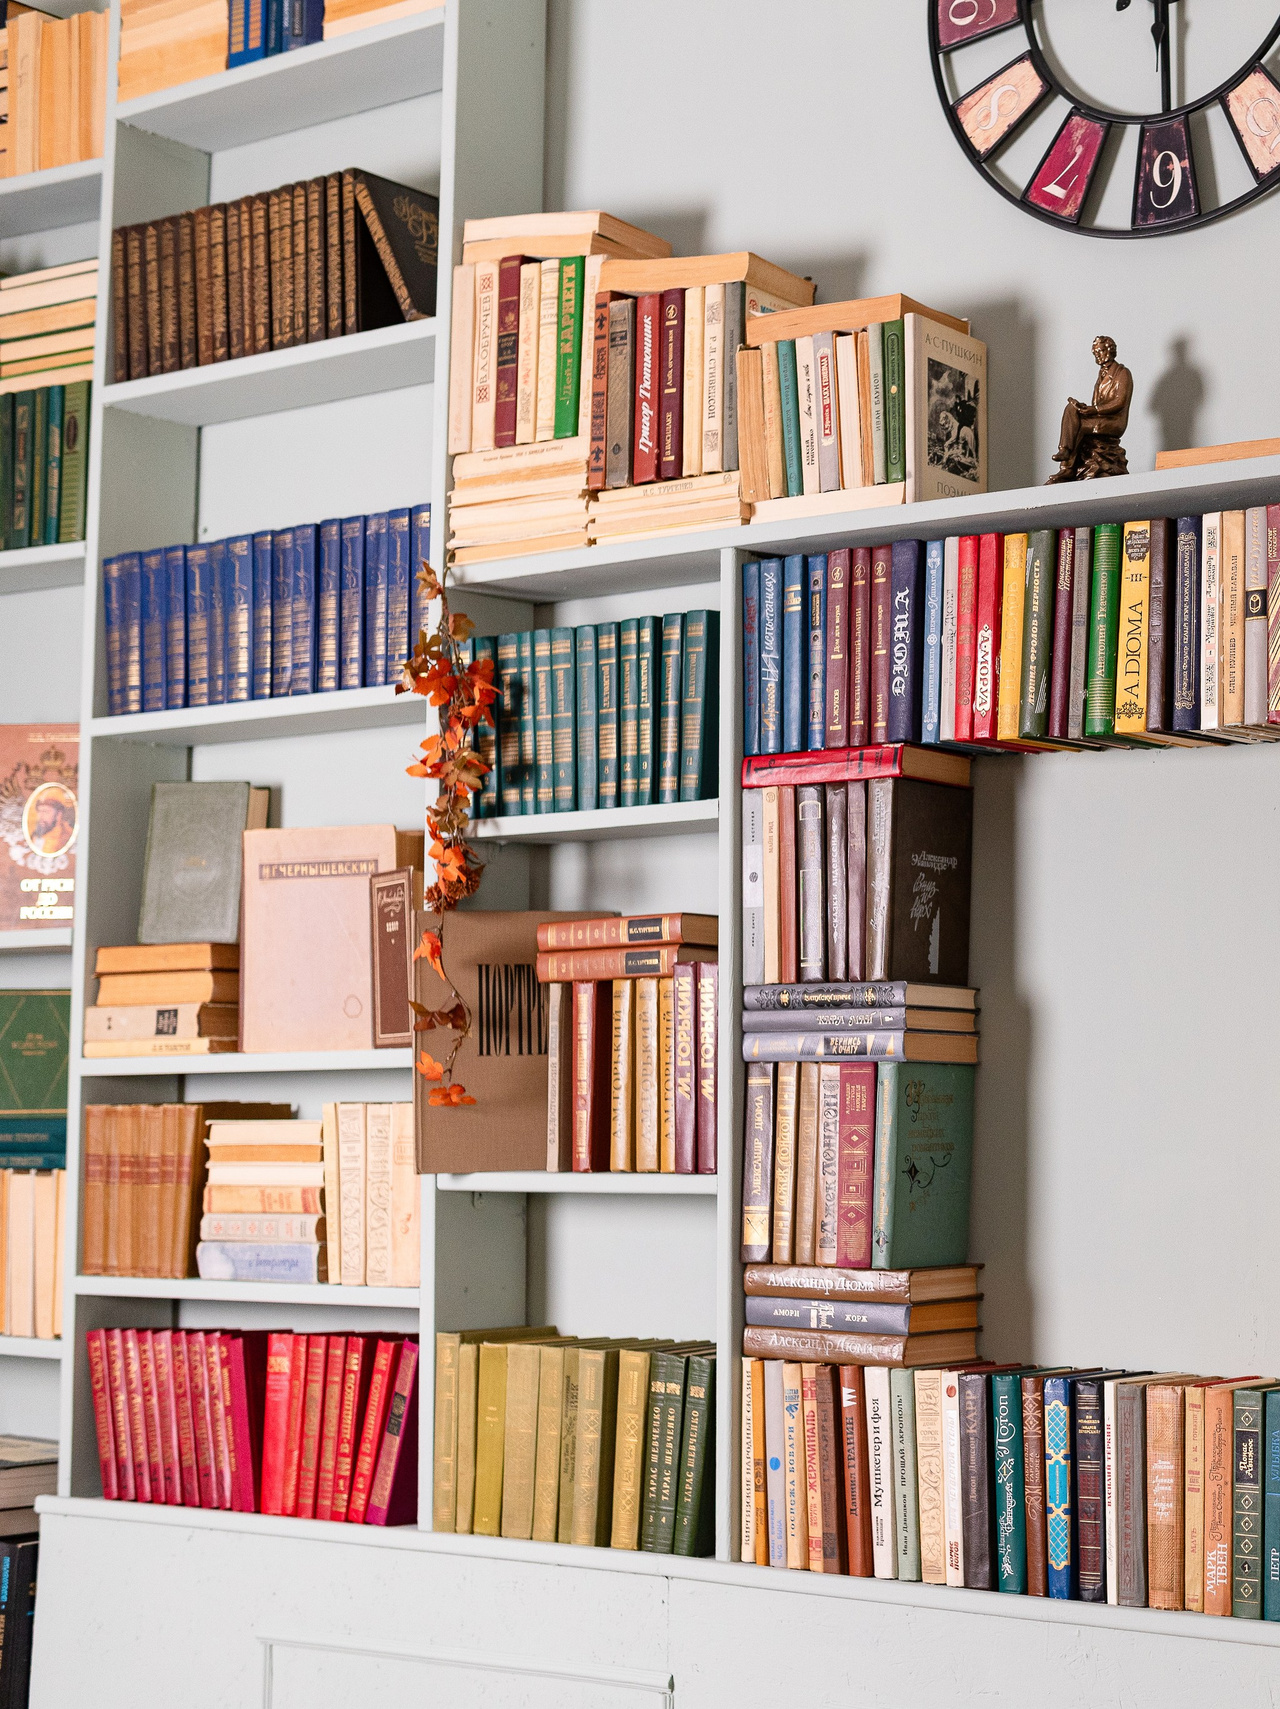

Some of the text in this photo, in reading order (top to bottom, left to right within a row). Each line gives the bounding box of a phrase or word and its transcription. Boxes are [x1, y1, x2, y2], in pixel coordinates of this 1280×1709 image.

[560, 264, 576, 355] КАРНЕГИ
[639, 314, 653, 454] Григор Тютюнник
[708, 357, 717, 420] СТИВЕНСОН
[763, 572, 777, 651] испытаниях
[891, 586, 911, 697] ДЮМА
[1027, 559, 1041, 705] ЛЕОНИД ФРОЛОВ ВЕРНОСТЬ
[1095, 572, 1108, 678] Анатолий Ткаченко
[675, 976, 691, 1066] ГОРЬКИЙ
[698, 977, 715, 1068] ГОРЬКИЙ
[752, 1138, 763, 1196] АЛЕКСАНДР
[650, 1406, 661, 1463] ШЕВЧЕНКО
[664, 1406, 676, 1465] ШЕВЧЕНКО
[686, 1409, 699, 1467] ШЕВЧЕНКО
[870, 1398, 882, 1423] фея
[965, 1389, 977, 1433] КАРР
[805, 1410, 817, 1493] ЖЕРМИНАЛЬ
[846, 1416, 855, 1470] ГРАНИН
[871, 1436, 884, 1508] Мушкетер
[1271, 1429, 1280, 1481] УЛЫБКА
[1206, 1550, 1217, 1596] МАРК
[1216, 1542, 1228, 1586] ТВЕН
[1271, 1548, 1279, 1582] ПЕТР
